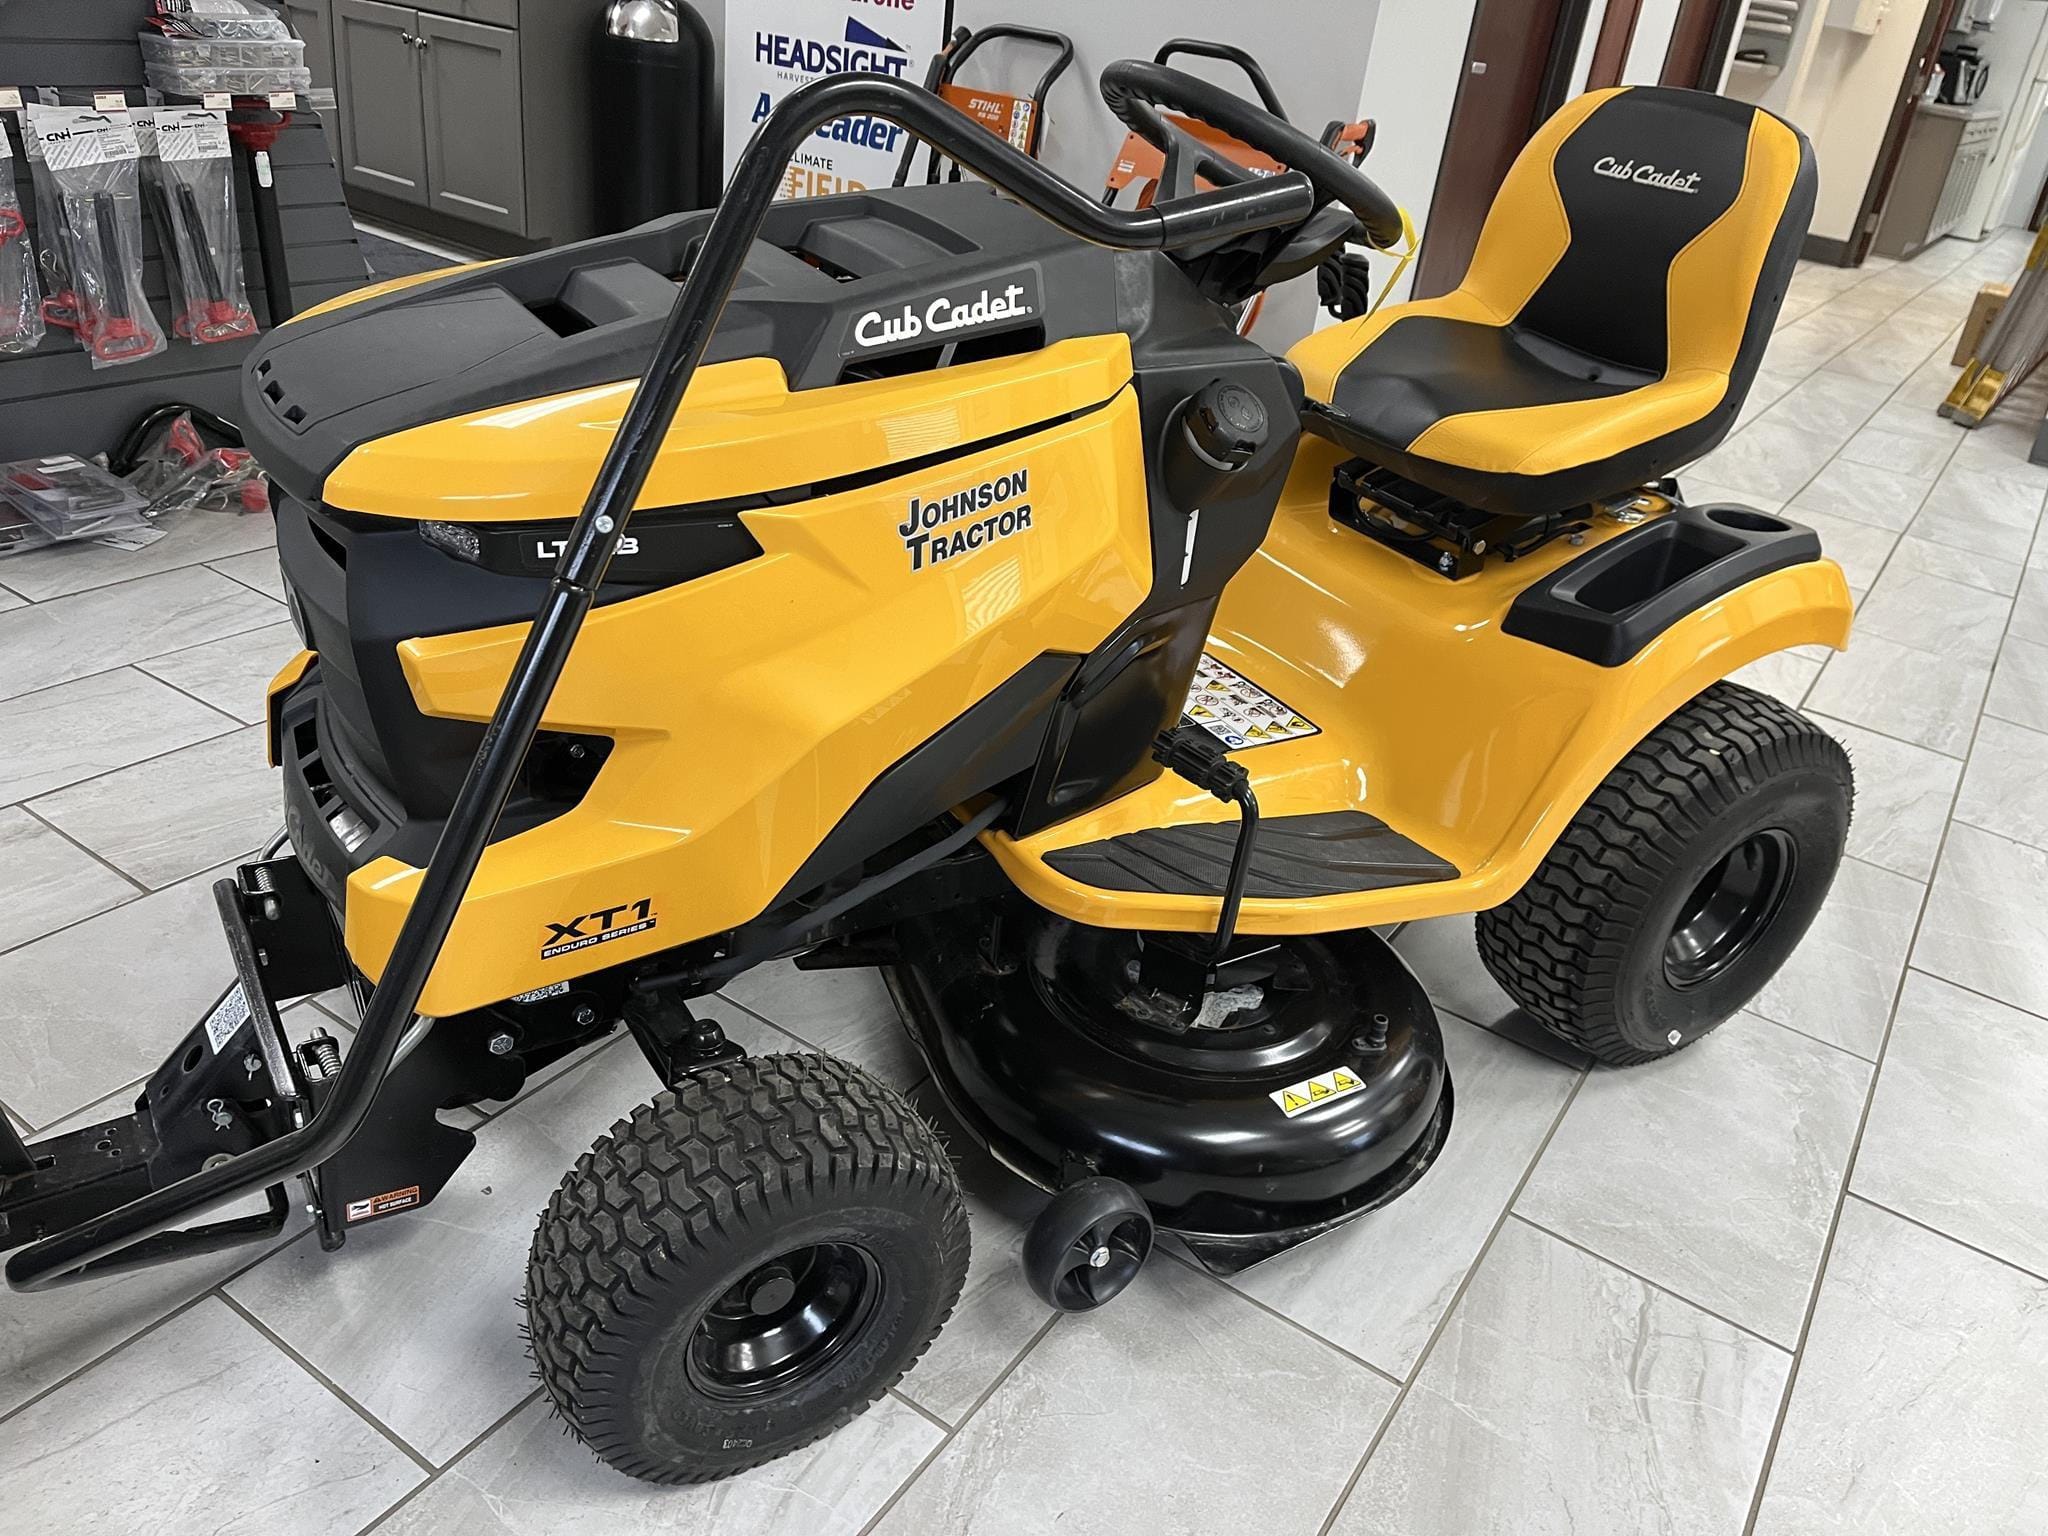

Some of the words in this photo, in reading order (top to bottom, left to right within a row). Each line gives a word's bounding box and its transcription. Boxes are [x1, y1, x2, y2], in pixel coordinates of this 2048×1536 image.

[968, 98, 1001, 114] STIHL
[815, 116, 903, 152] eader
[787, 153, 833, 170] LIMATE
[1593, 156, 1634, 180] Cub
[1632, 165, 1701, 193] Cadet
[854, 305, 923, 347] Cub
[925, 284, 1027, 332] Cadet
[898, 469, 1028, 537] JOHNSON
[906, 504, 1032, 571] TRACTOR
[543, 897, 652, 947] XT1
[543, 937, 598, 957] ENDURO
[601, 922, 647, 941] SERIES
[380, 1187, 418, 1202] WARNING
